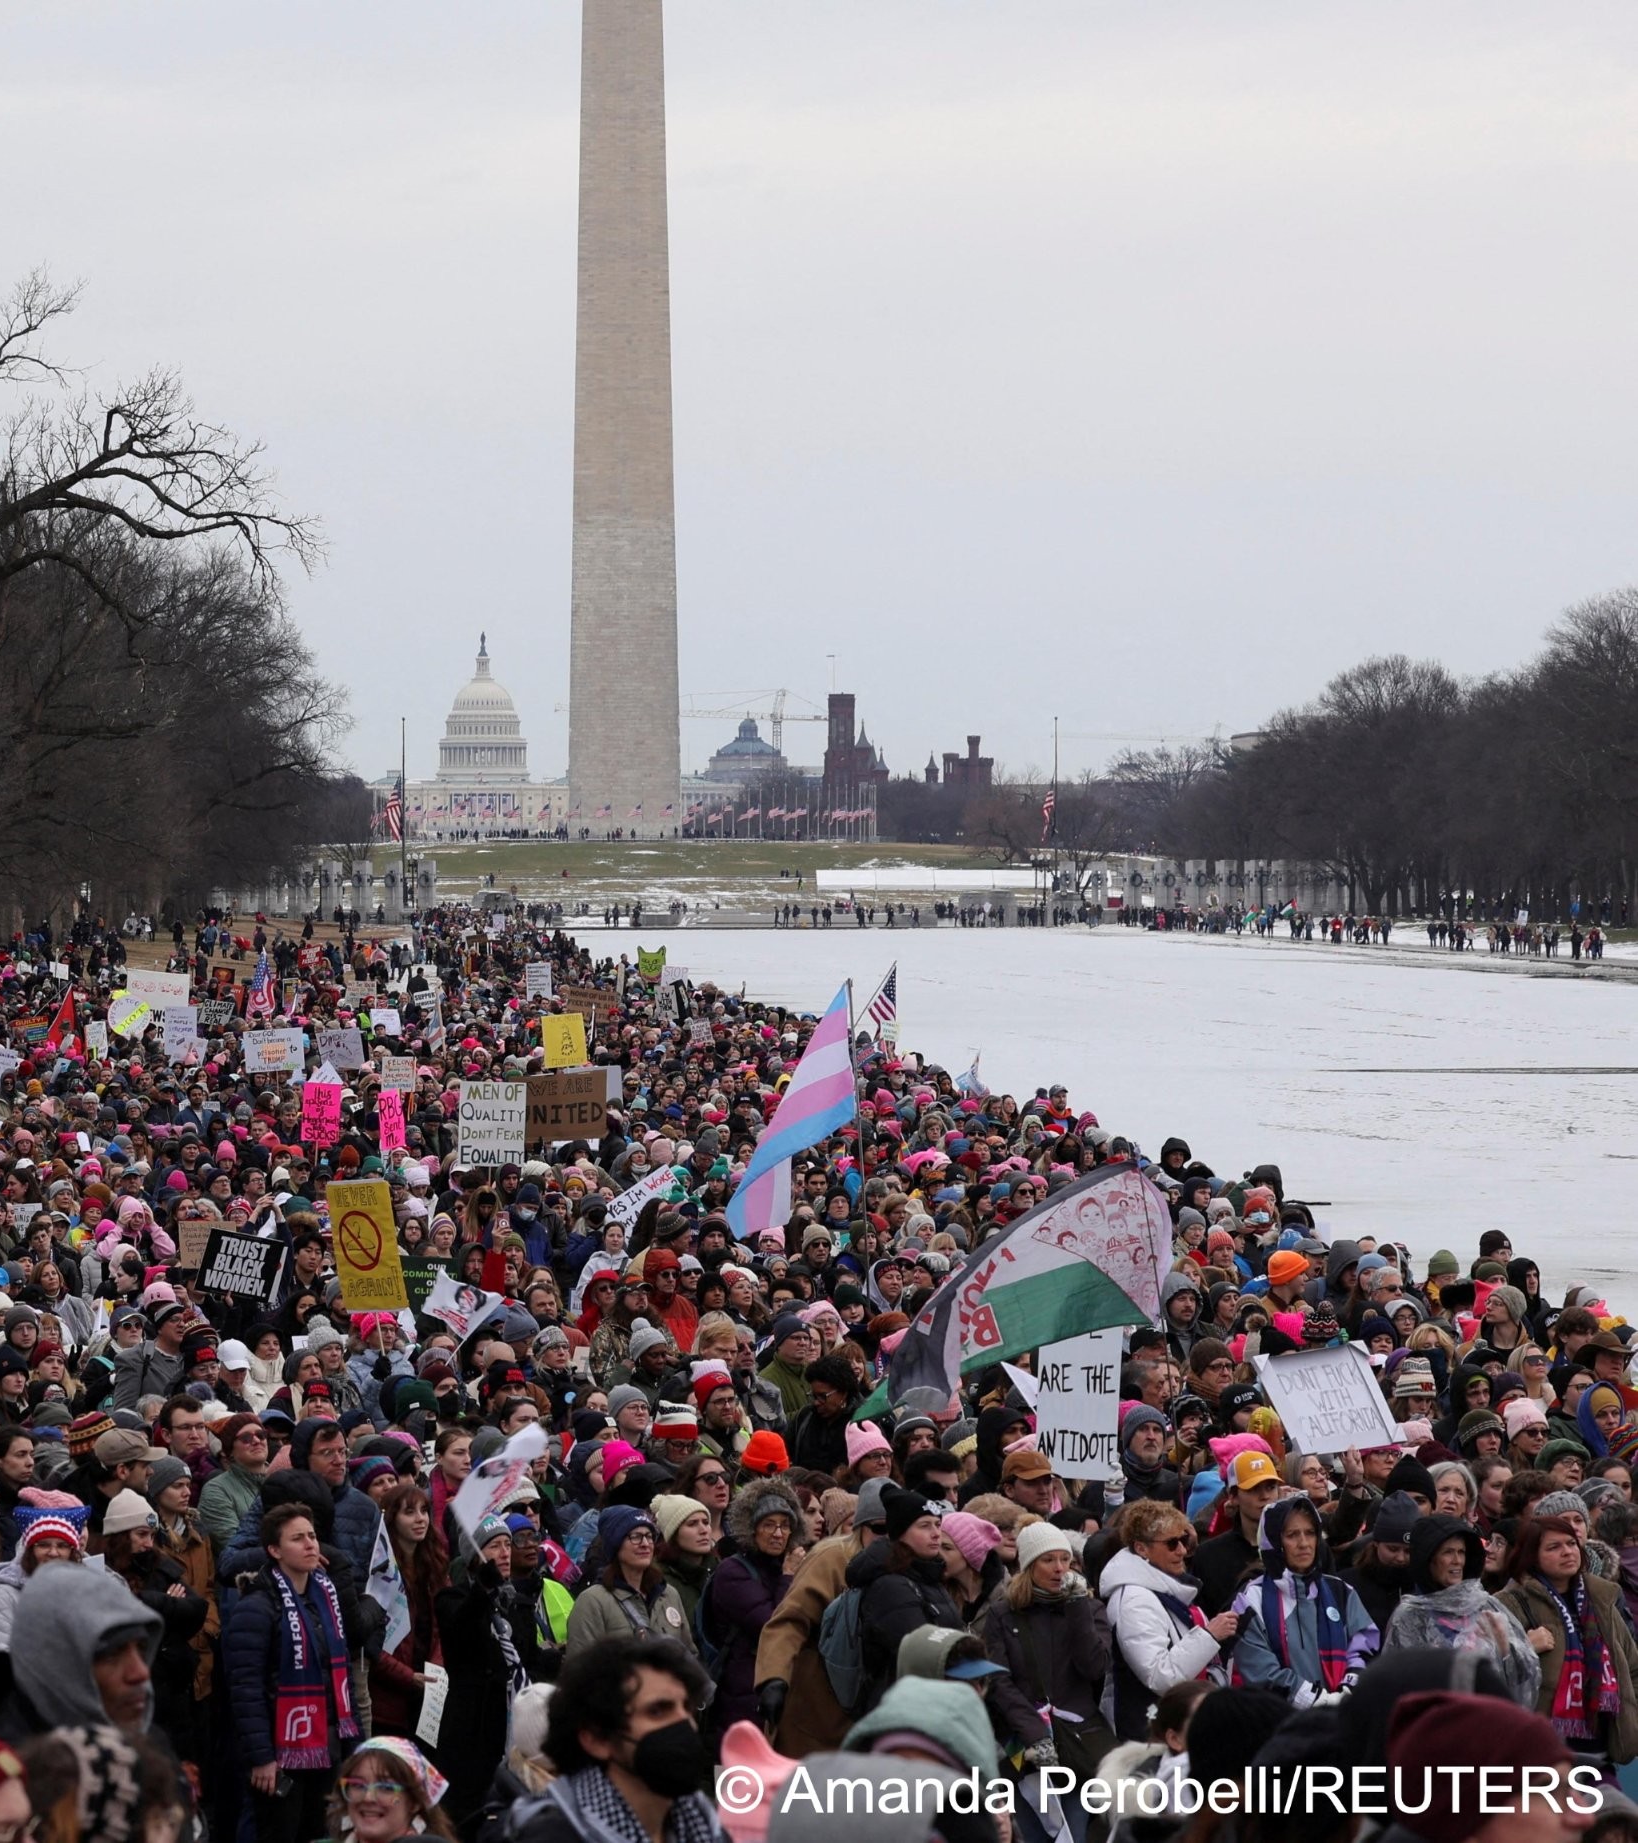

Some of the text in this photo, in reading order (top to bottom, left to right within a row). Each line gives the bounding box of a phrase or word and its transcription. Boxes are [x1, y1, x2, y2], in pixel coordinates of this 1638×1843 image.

[664, 966, 689, 977] STOP
[204, 1007, 230, 1015] CHANGE
[205, 1000, 233, 1010] CLIMATE
[257, 1045, 298, 1060] prisoner to
[467, 1084, 524, 1102] MEN OF
[527, 1078, 594, 1097] WE ARE
[316, 1106, 324, 1116] of
[378, 1095, 402, 1121] RBG
[461, 1102, 524, 1122] QUALITY
[462, 1128, 524, 1140] DONT FEAR
[460, 1145, 524, 1165] EQUALITY
[334, 1186, 378, 1208] NEVER
[607, 1170, 674, 1218] YES I'M WOKE
[622, 1215, 635, 1228] HY
[220, 1236, 270, 1260] TRUST
[213, 1253, 265, 1278] BLACK
[426, 1263, 446, 1271] OUR
[204, 1269, 266, 1298] WOMEN.
[348, 1266, 402, 1300] AGAIN!
[1038, 1362, 1116, 1394] ARE THE
[1325, 1362, 1365, 1388] FUCK
[1307, 1388, 1355, 1412] WITH
[1037, 1428, 1118, 1466] ANTIDOTE
[288, 1609, 304, 1670] I'M FOR
